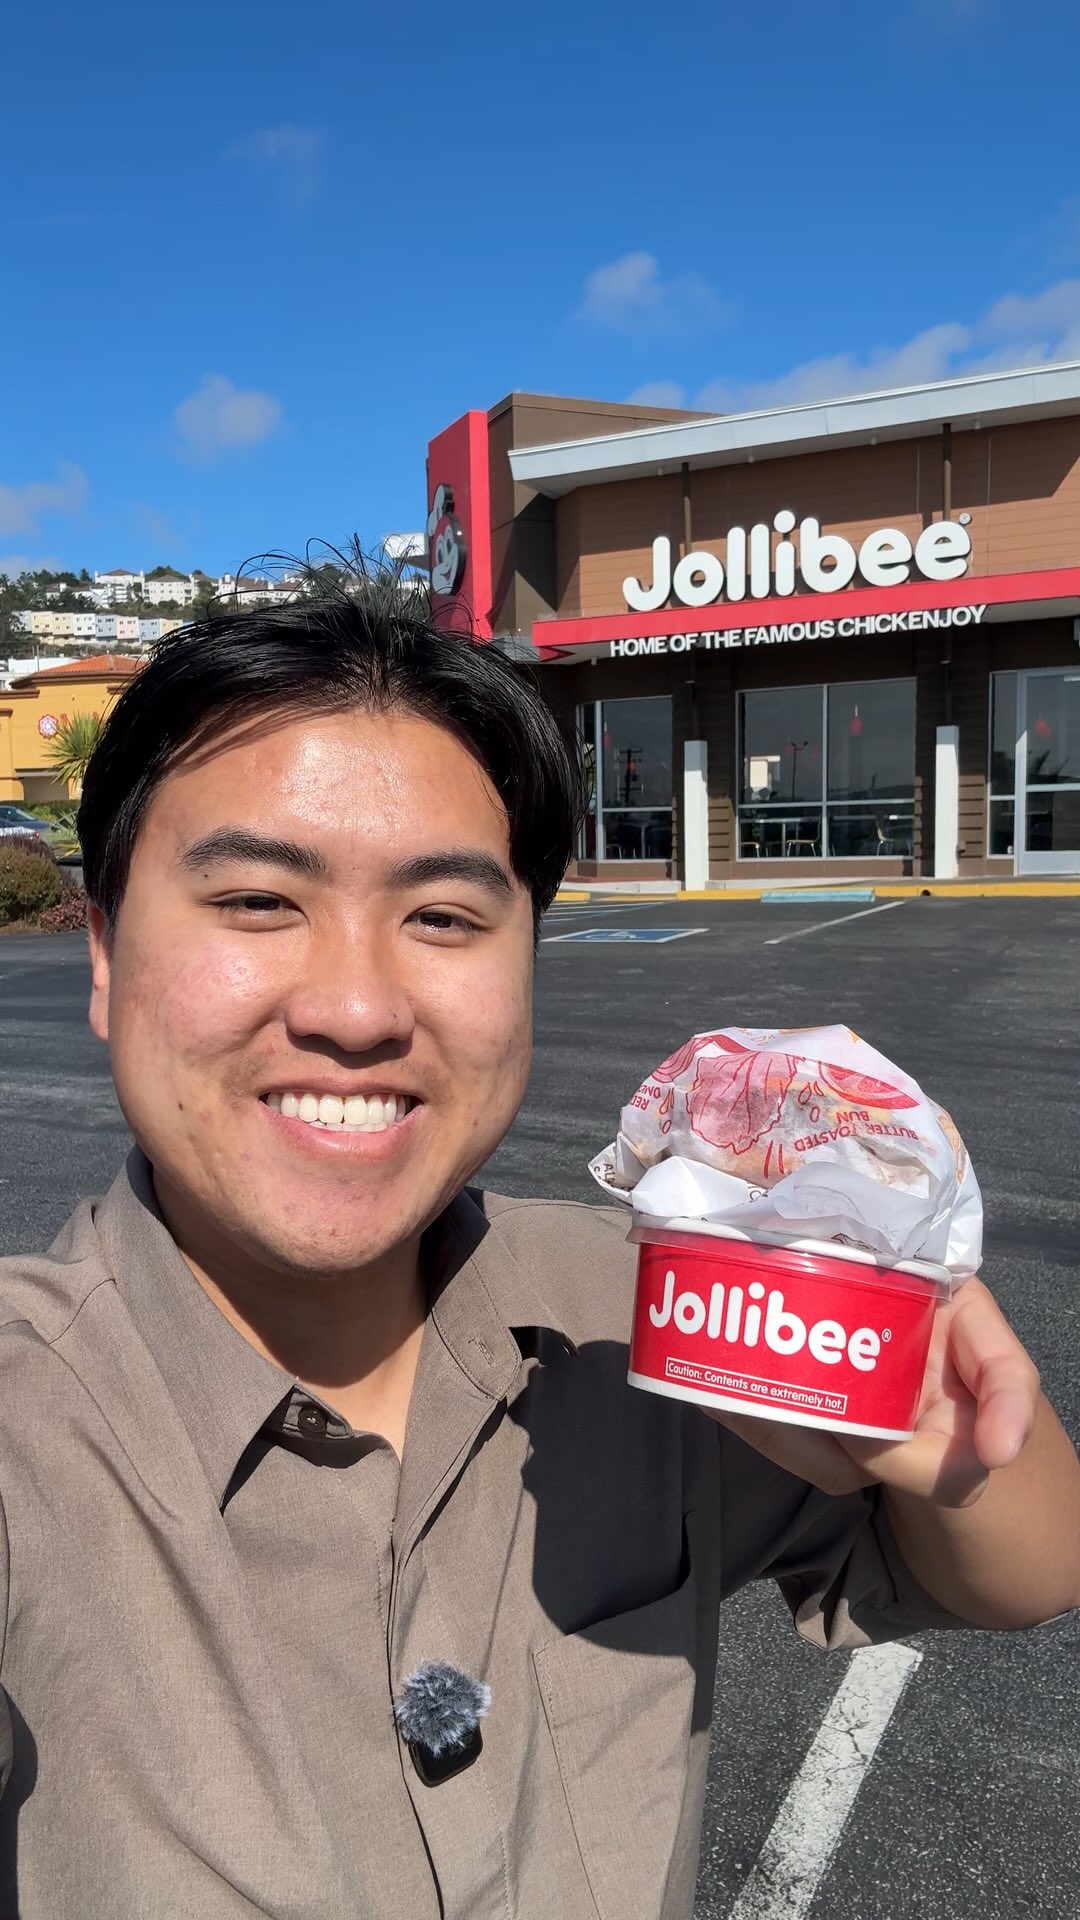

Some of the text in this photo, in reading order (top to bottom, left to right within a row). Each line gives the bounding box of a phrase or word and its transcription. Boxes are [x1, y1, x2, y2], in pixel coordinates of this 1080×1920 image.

[609, 604, 987, 658] HOME OF THE FAMOUS CHICKENJOY
[835, 1110, 871, 1124] BUN
[793, 1123, 919, 1152] BUTTER TOASTED
[667, 1362, 844, 1410] Caution: Contents are extremely hot.
